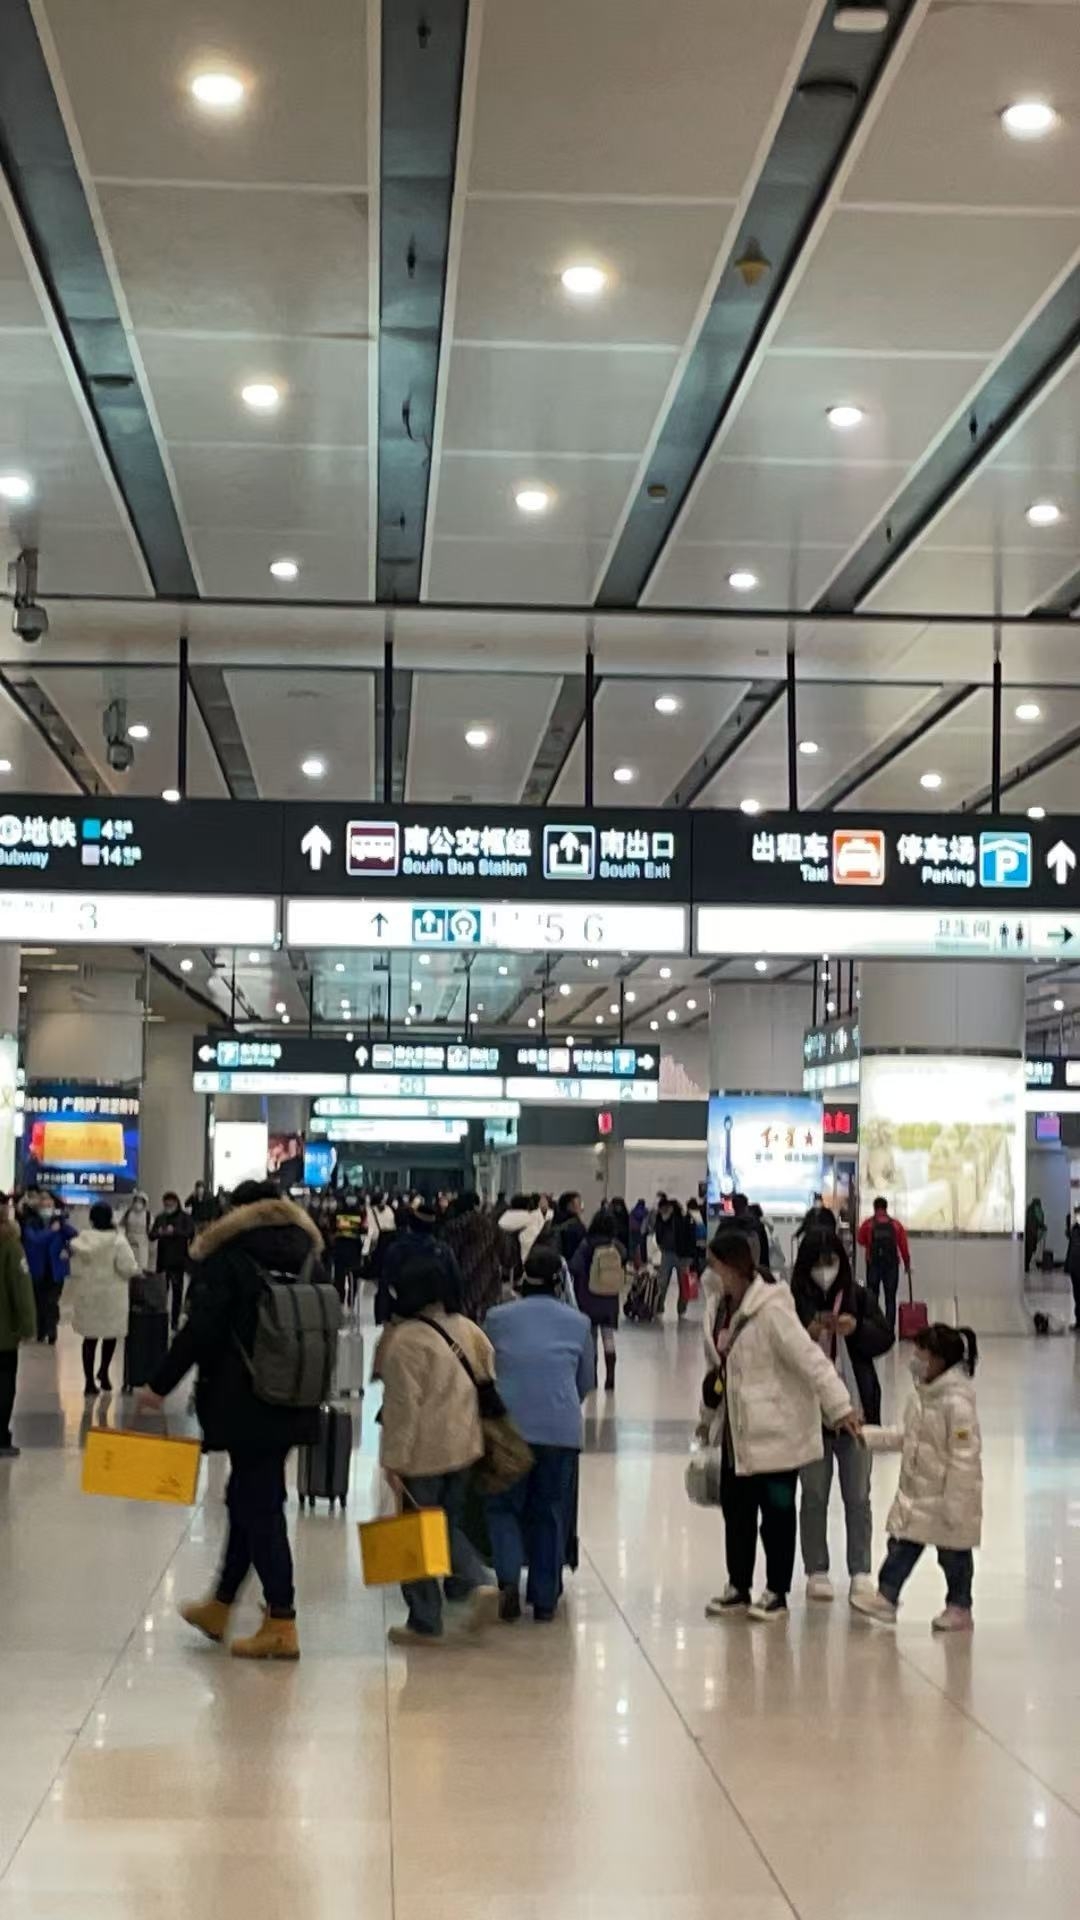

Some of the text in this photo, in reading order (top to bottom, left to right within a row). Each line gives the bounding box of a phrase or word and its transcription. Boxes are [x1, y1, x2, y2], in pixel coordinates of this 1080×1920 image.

[22, 815, 77, 847] 地铁
[404, 824, 531, 857] 南公交枢纽
[600, 828, 674, 860] 南出口
[752, 831, 828, 863] 出租车
[897, 834, 976, 865] 停车场
[403, 857, 527, 876] South Bus Station
[600, 861, 671, 879] South Exit
[800, 864, 828, 882] Taxi
[922, 866, 976, 887] Parking
[583, 913, 603, 943] 6
